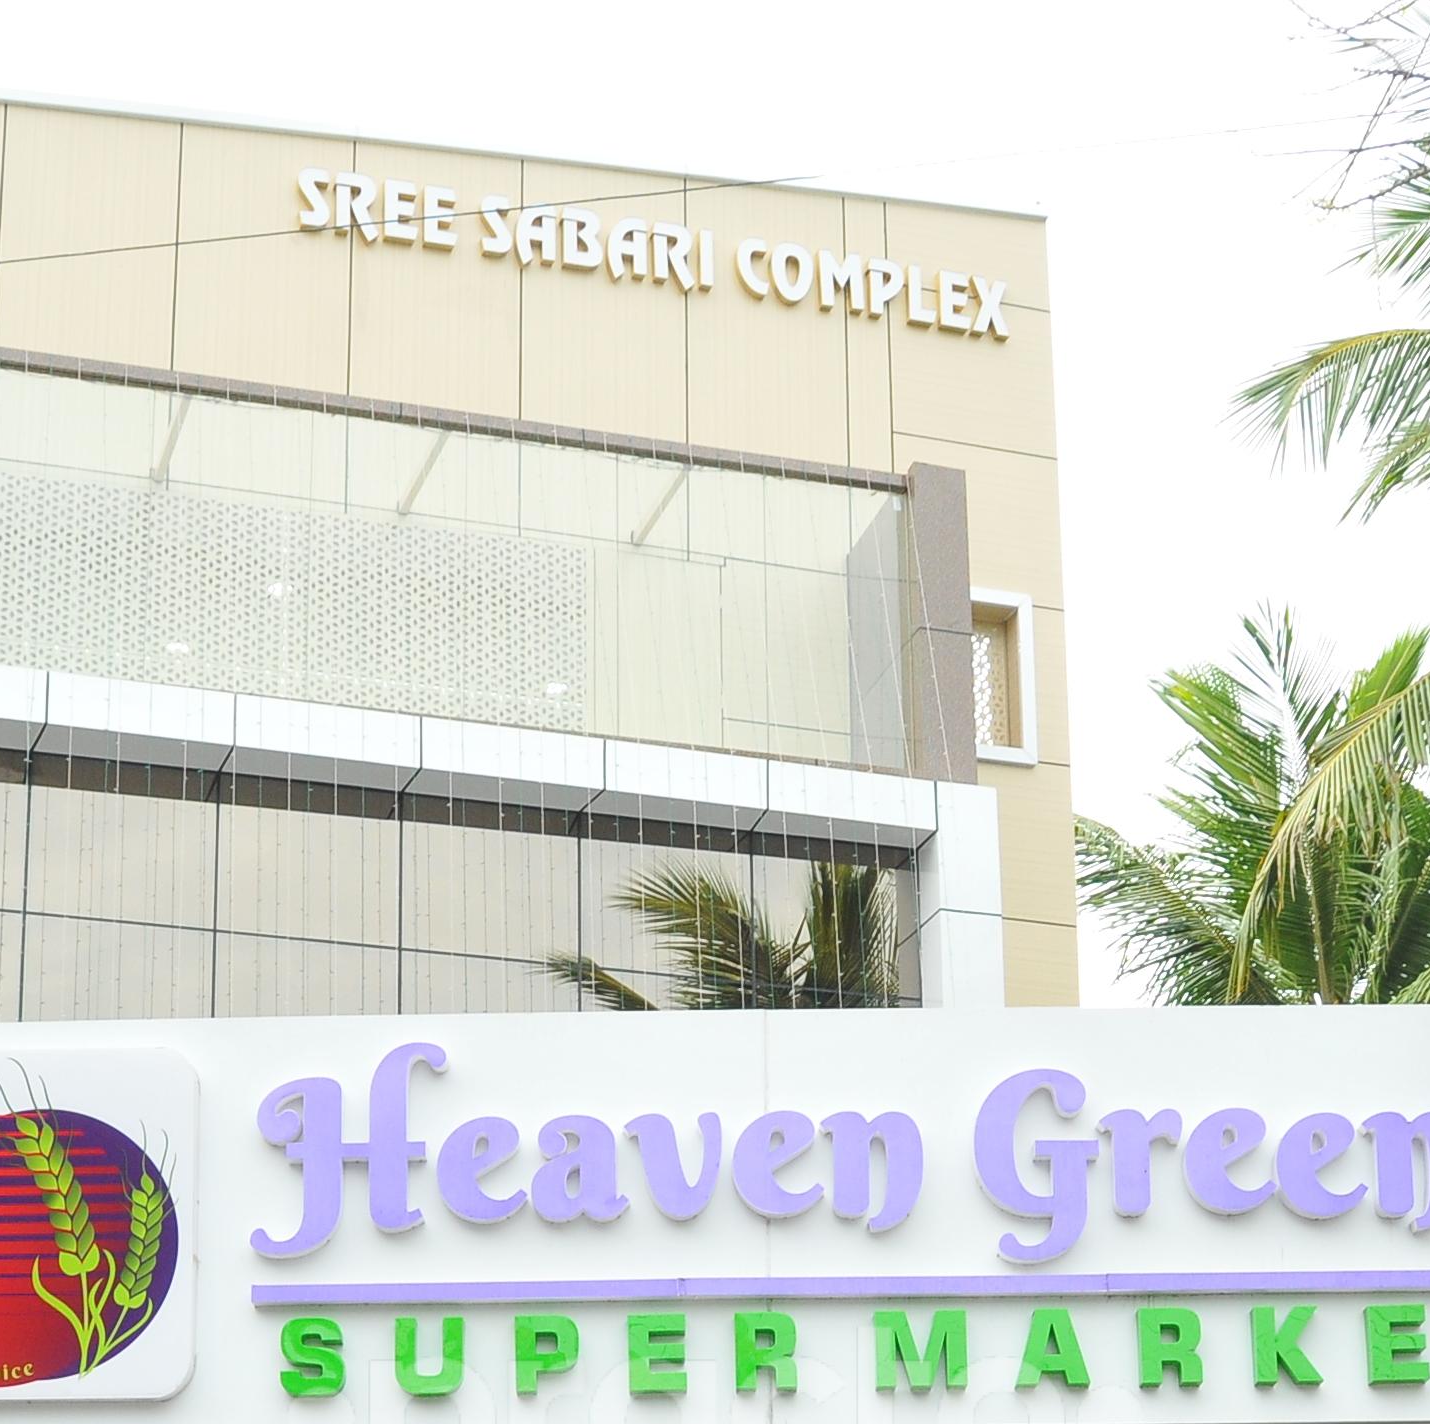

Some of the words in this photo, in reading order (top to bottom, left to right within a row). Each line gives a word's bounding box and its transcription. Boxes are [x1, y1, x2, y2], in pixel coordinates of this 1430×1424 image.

[296, 166, 458, 251] SREE
[480, 194, 714, 294] SABARI
[735, 237, 1011, 343] COMPLEX
[249, 1041, 925, 1260] Heaven
[279, 1309, 799, 1399] SUPER
